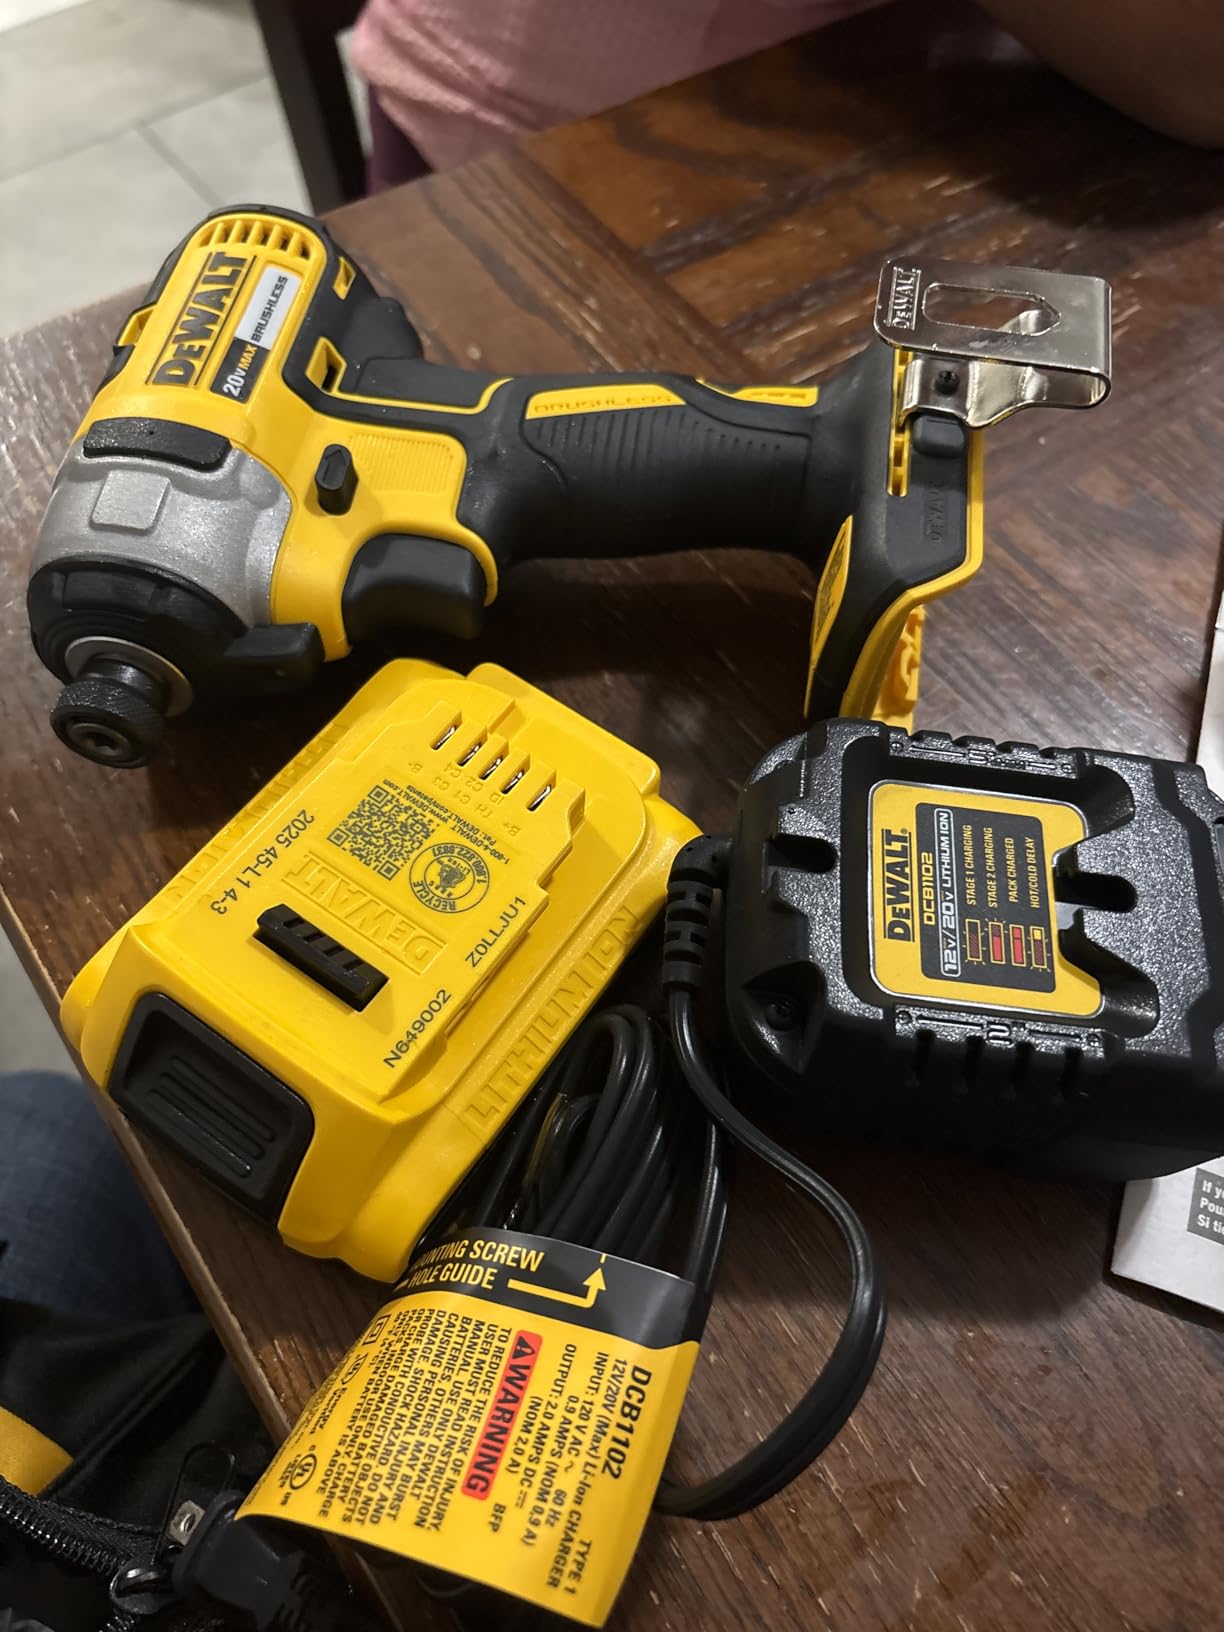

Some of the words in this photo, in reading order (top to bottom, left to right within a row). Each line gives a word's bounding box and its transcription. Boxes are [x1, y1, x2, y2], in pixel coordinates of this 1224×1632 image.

[152, 252, 248, 385] DEWALT
[251, 276, 288, 342] BRUSHLESS
[223, 368, 246, 397] 20V
[240, 344, 258, 370] MAX
[382, 778, 449, 824] www.DEWALT.com
[275, 809, 315, 848] 2025
[939, 812, 950, 837] ION
[940, 838, 952, 888] LITHIUM
[962, 824, 974, 869] CHARGING
[984, 827, 995, 872] CHARGING
[1004, 837, 1017, 878] CHARGED
[1024, 836, 1038, 865] DELAY
[210, 888, 238, 915] 4-3
[414, 880, 456, 911] RECYCLE
[884, 829, 912, 942] DEWALT
[921, 852, 936, 926] DCB1102
[965, 875, 977, 906] STAGE
[986, 879, 998, 908] STAGE
[1008, 879, 1019, 903] PACK
[1026, 865, 1040, 909] HOT/COLD
[383, 988, 452, 1068] N649002
[464, 969, 594, 1119] LITHIUM
[582, 905, 641, 970] ION
[1202, 1180, 1213, 1193] If
[1197, 1214, 1210, 1229] Si
[1200, 1197, 1224, 1216] Pou
[471, 1239, 544, 1272] SCREW
[410, 1265, 440, 1289] HOLE
[440, 1262, 498, 1290] GUIDE
[391, 1309, 410, 1336] ONLY
[411, 1307, 435, 1345] PROBE
[412, 1307, 425, 1323] OR
[496, 1325, 511, 1343] TO
[371, 1338, 395, 1375] WHEN
[389, 1324, 417, 1372] CHARGE
[416, 1309, 446, 1365] DAMAGE.
[429, 1311, 459, 1368] CAUSING
[477, 1323, 497, 1356] USER
[369, 1348, 397, 1394] INDOOR
[398, 1346, 419, 1378] WITH
[463, 1357, 486, 1395] MUST
[478, 1345, 505, 1395] REDUCE
[548, 1342, 576, 1399] OUTPUT:
[584, 1351, 608, 1396] INPUT:
[346, 1377, 375, 1431] BATTERY
[399, 1367, 424, 1410] SHOCK
[402, 1370, 438, 1438] PERSONAL
[445, 1379, 464, 1405] USE
[563, 1394, 579, 1414] 0.9
[600, 1357, 627, 1413] 12V/20V
[357, 1396, 374, 1422] USE
[361, 1374, 395, 1439] DAMAGED
[364, 1379, 405, 1461] CONDUCTIVE
[418, 1387, 446, 1438] OTHERS
[431, 1407, 453, 1441] ONLY
[450, 1397, 471, 1431] READ
[468, 1396, 487, 1422] THE
[519, 1395, 543, 1434] (NOM
[541, 1399, 557, 1420] 2.0
[577, 1398, 594, 1421] 120
[600, 1365, 652, 1479] DCB1102
[337, 1434, 348, 1447] IS
[375, 1412, 407, 1469] HAZARD.
[456, 1423, 477, 1456] RISK
[465, 1358, 531, 1495] WARNING
[527, 1420, 551, 1464] AMPS
[549, 1415, 572, 1459] AMPS
[566, 1434, 583, 1457] AC
[573, 1423, 587, 1434] V
[585, 1413, 612, 1459] (Max)
[291, 1459, 313, 1484] UL
[315, 1449, 341, 1495] ABOVE
[335, 1441, 368, 1503] BATTERY
[381, 1439, 410, 1490] INJURY
[404, 1439, 426, 1471] MAY
[408, 1443, 439, 1500] DEWALT
[448, 1457, 464, 1476] OF
[504, 1456, 522, 1475] A)
[318, 1462, 347, 1517] CHARGE
[341, 1462, 372, 1522] OBJECTS
[365, 1472, 382, 1493] DO
[385, 1473, 412, 1520] BURST
[413, 1434, 458, 1527] INSTRUCTION
[519, 1466, 536, 1488] DC
[534, 1459, 560, 1503] (NOM
[551, 1487, 567, 1506] 60
[353, 1495, 374, 1525] NOT
[368, 1492, 389, 1525] AND
[486, 1502, 506, 1532] BFP
[544, 1508, 561, 1528] Hz
[519, 1527, 538, 1547] A)
[546, 1509, 582, 1588] CHARGER
[566, 1538, 592, 1581] TYPE
[563, 1584, 577, 1594] 1
